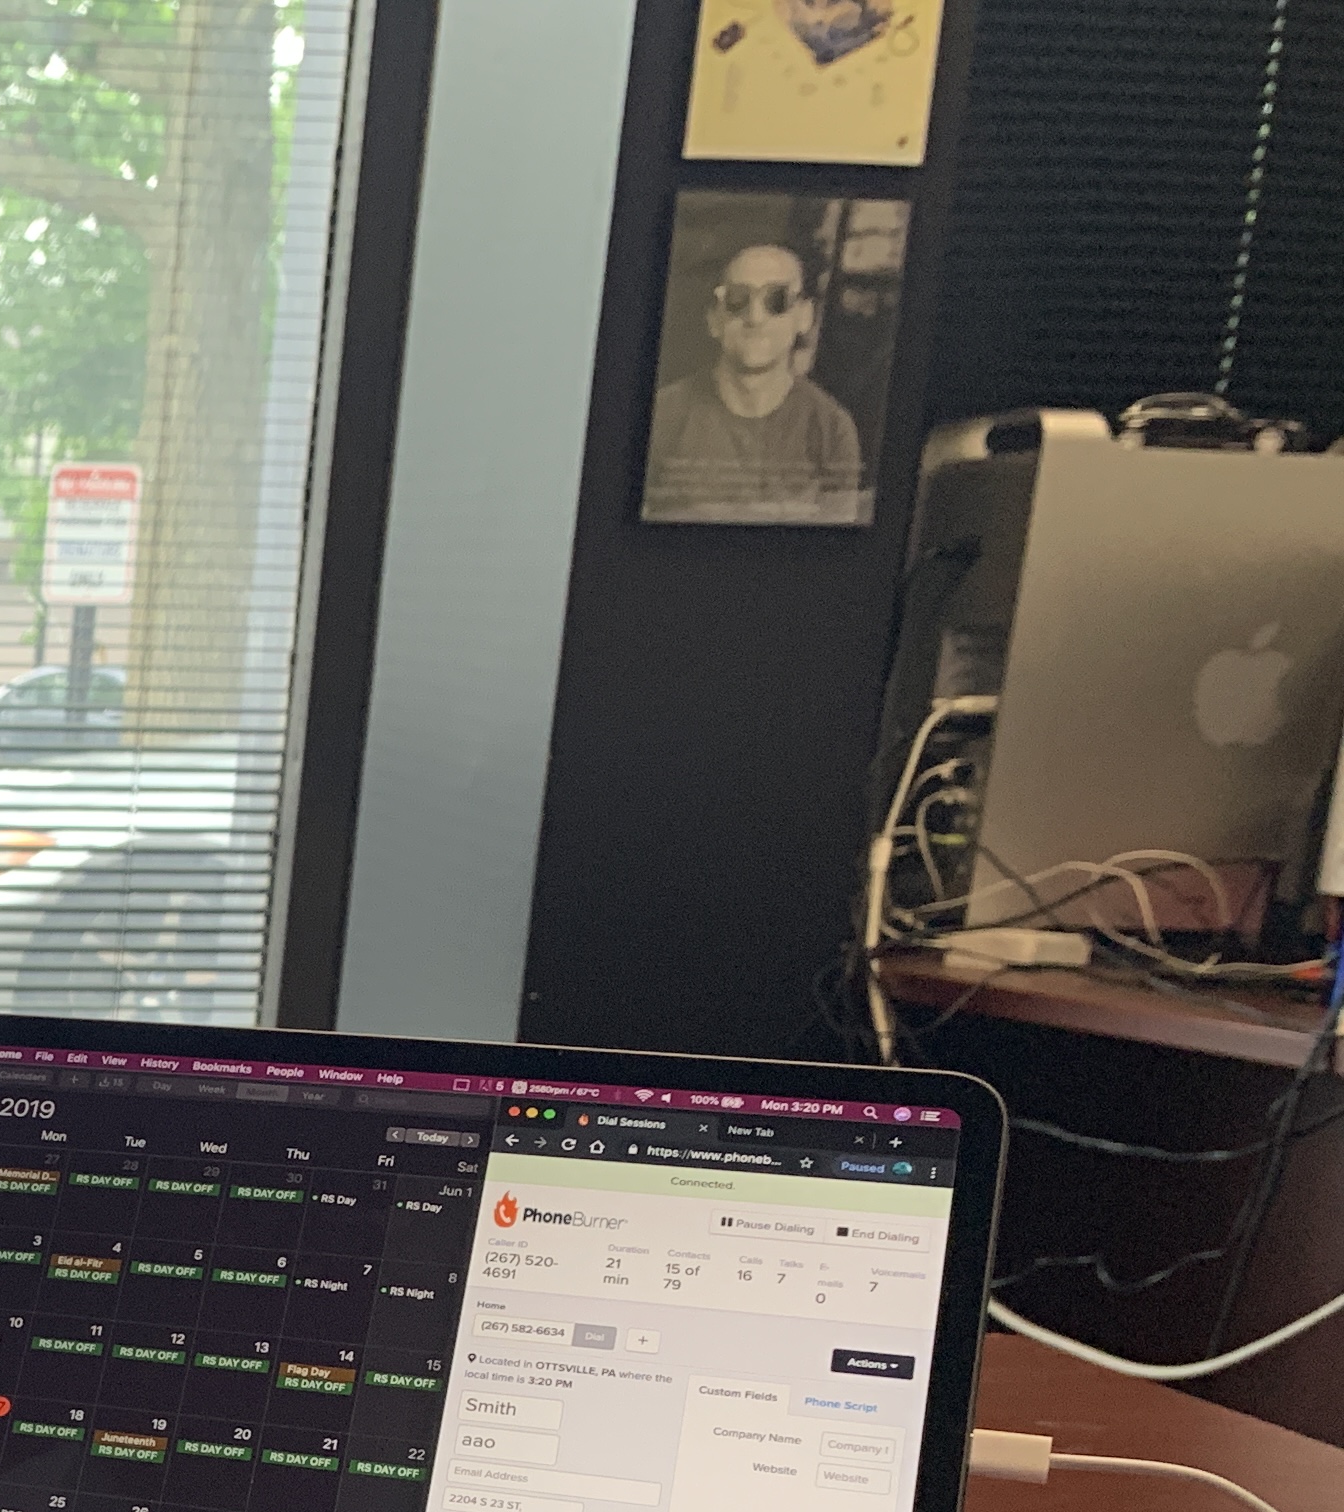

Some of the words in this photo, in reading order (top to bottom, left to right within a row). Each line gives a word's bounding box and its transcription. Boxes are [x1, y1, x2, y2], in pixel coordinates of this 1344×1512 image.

[35, 1051, 54, 1062] File
[67, 1053, 88, 1063] Edit
[101, 1055, 127, 1066] View
[141, 1058, 179, 1070] History
[193, 1061, 252, 1074] Bookmarks
[266, 1066, 304, 1079] People
[319, 1070, 363, 1081] Window
[377, 1073, 404, 1086] Help
[761, 1100, 788, 1111] Mon
[792, 1102, 820, 1114] 3:20
[822, 1104, 843, 1115] PM
[597, 1115, 618, 1126] Dial
[620, 1118, 666, 1129] Sessions
[41, 1130, 67, 1142] Mon
[727, 1125, 752, 1136] New
[755, 1127, 774, 1137] Tab
[125, 1136, 146, 1148] Tue
[417, 1132, 449, 1144] Today
[200, 1142, 227, 1154] Wed
[286, 1148, 310, 1160] Thu
[378, 1155, 394, 1167] Fri
[457, 1161, 479, 1173] Sat
[841, 1161, 885, 1174] Paused
[670, 1176, 736, 1190] Connected.
[522, 1207, 624, 1230] PhoneBurner
[736, 1219, 771, 1231] Pause
[775, 1223, 814, 1235] Dialing
[852, 1229, 874, 1240] End
[878, 1232, 919, 1244] Dialing
[488, 1238, 515, 1248] Caller
[518, 1240, 528, 1248] ID
[608, 1244, 649, 1255] Duration
[667, 1249, 711, 1260] Contacts
[485, 1251, 520, 1266] (267)
[525, 1255, 558, 1267] 520-
[606, 1258, 621, 1269] 21
[482, 1267, 517, 1279] 4691
[665, 1263, 681, 1274] 15
[685, 1265, 700, 1276] of
[738, 1270, 753, 1281] 16
[872, 1267, 926, 1280] Voicemails
[304, 1279, 318, 1288] RS
[321, 1280, 348, 1291] Night
[603, 1275, 629, 1286] min
[663, 1279, 682, 1290] 79
[10, 1318, 23, 1328] 10
[91, 1325, 102, 1335] 11
[171, 1334, 185, 1344] 12
[585, 1332, 604, 1342] Dial
[255, 1342, 269, 1353] 13
[339, 1351, 354, 1362] 14
[427, 1360, 441, 1370] 15
[479, 1356, 520, 1368] Located
[524, 1361, 533, 1369] in
[535, 1362, 598, 1376] OTTSVILLE,
[602, 1368, 616, 1378] PA
[619, 1371, 652, 1382] where
[655, 1374, 672, 1383] the
[847, 1358, 888, 1370] Actions
[287, 1365, 309, 1376] Flag
[311, 1367, 330, 1379] Day
[285, 1377, 298, 1386] RS
[300, 1379, 322, 1389] DAY
[324, 1382, 346, 1391] OFF
[465, 1370, 489, 1380] local
[491, 1373, 514, 1383] time
[517, 1376, 525, 1384] is
[528, 1377, 552, 1387] 3:20
[556, 1379, 573, 1389] PM
[699, 1386, 742, 1398] Custom
[745, 1390, 778, 1402] Fields
[465, 1398, 517, 1416] Smith
[805, 1397, 841, 1409] Phone
[844, 1401, 878, 1413] Script
[101, 1433, 156, 1447] Juneteenth
[713, 1427, 766, 1442] Company
[769, 1434, 802, 1445] Name
[462, 1436, 496, 1449] aao
[828, 1440, 882, 1456] Company
[454, 1467, 483, 1478] Email
[484, 1470, 528, 1482] Address
[753, 1463, 797, 1476] Website
[824, 1471, 869, 1484] Website
[49, 1496, 66, 1508] 25
